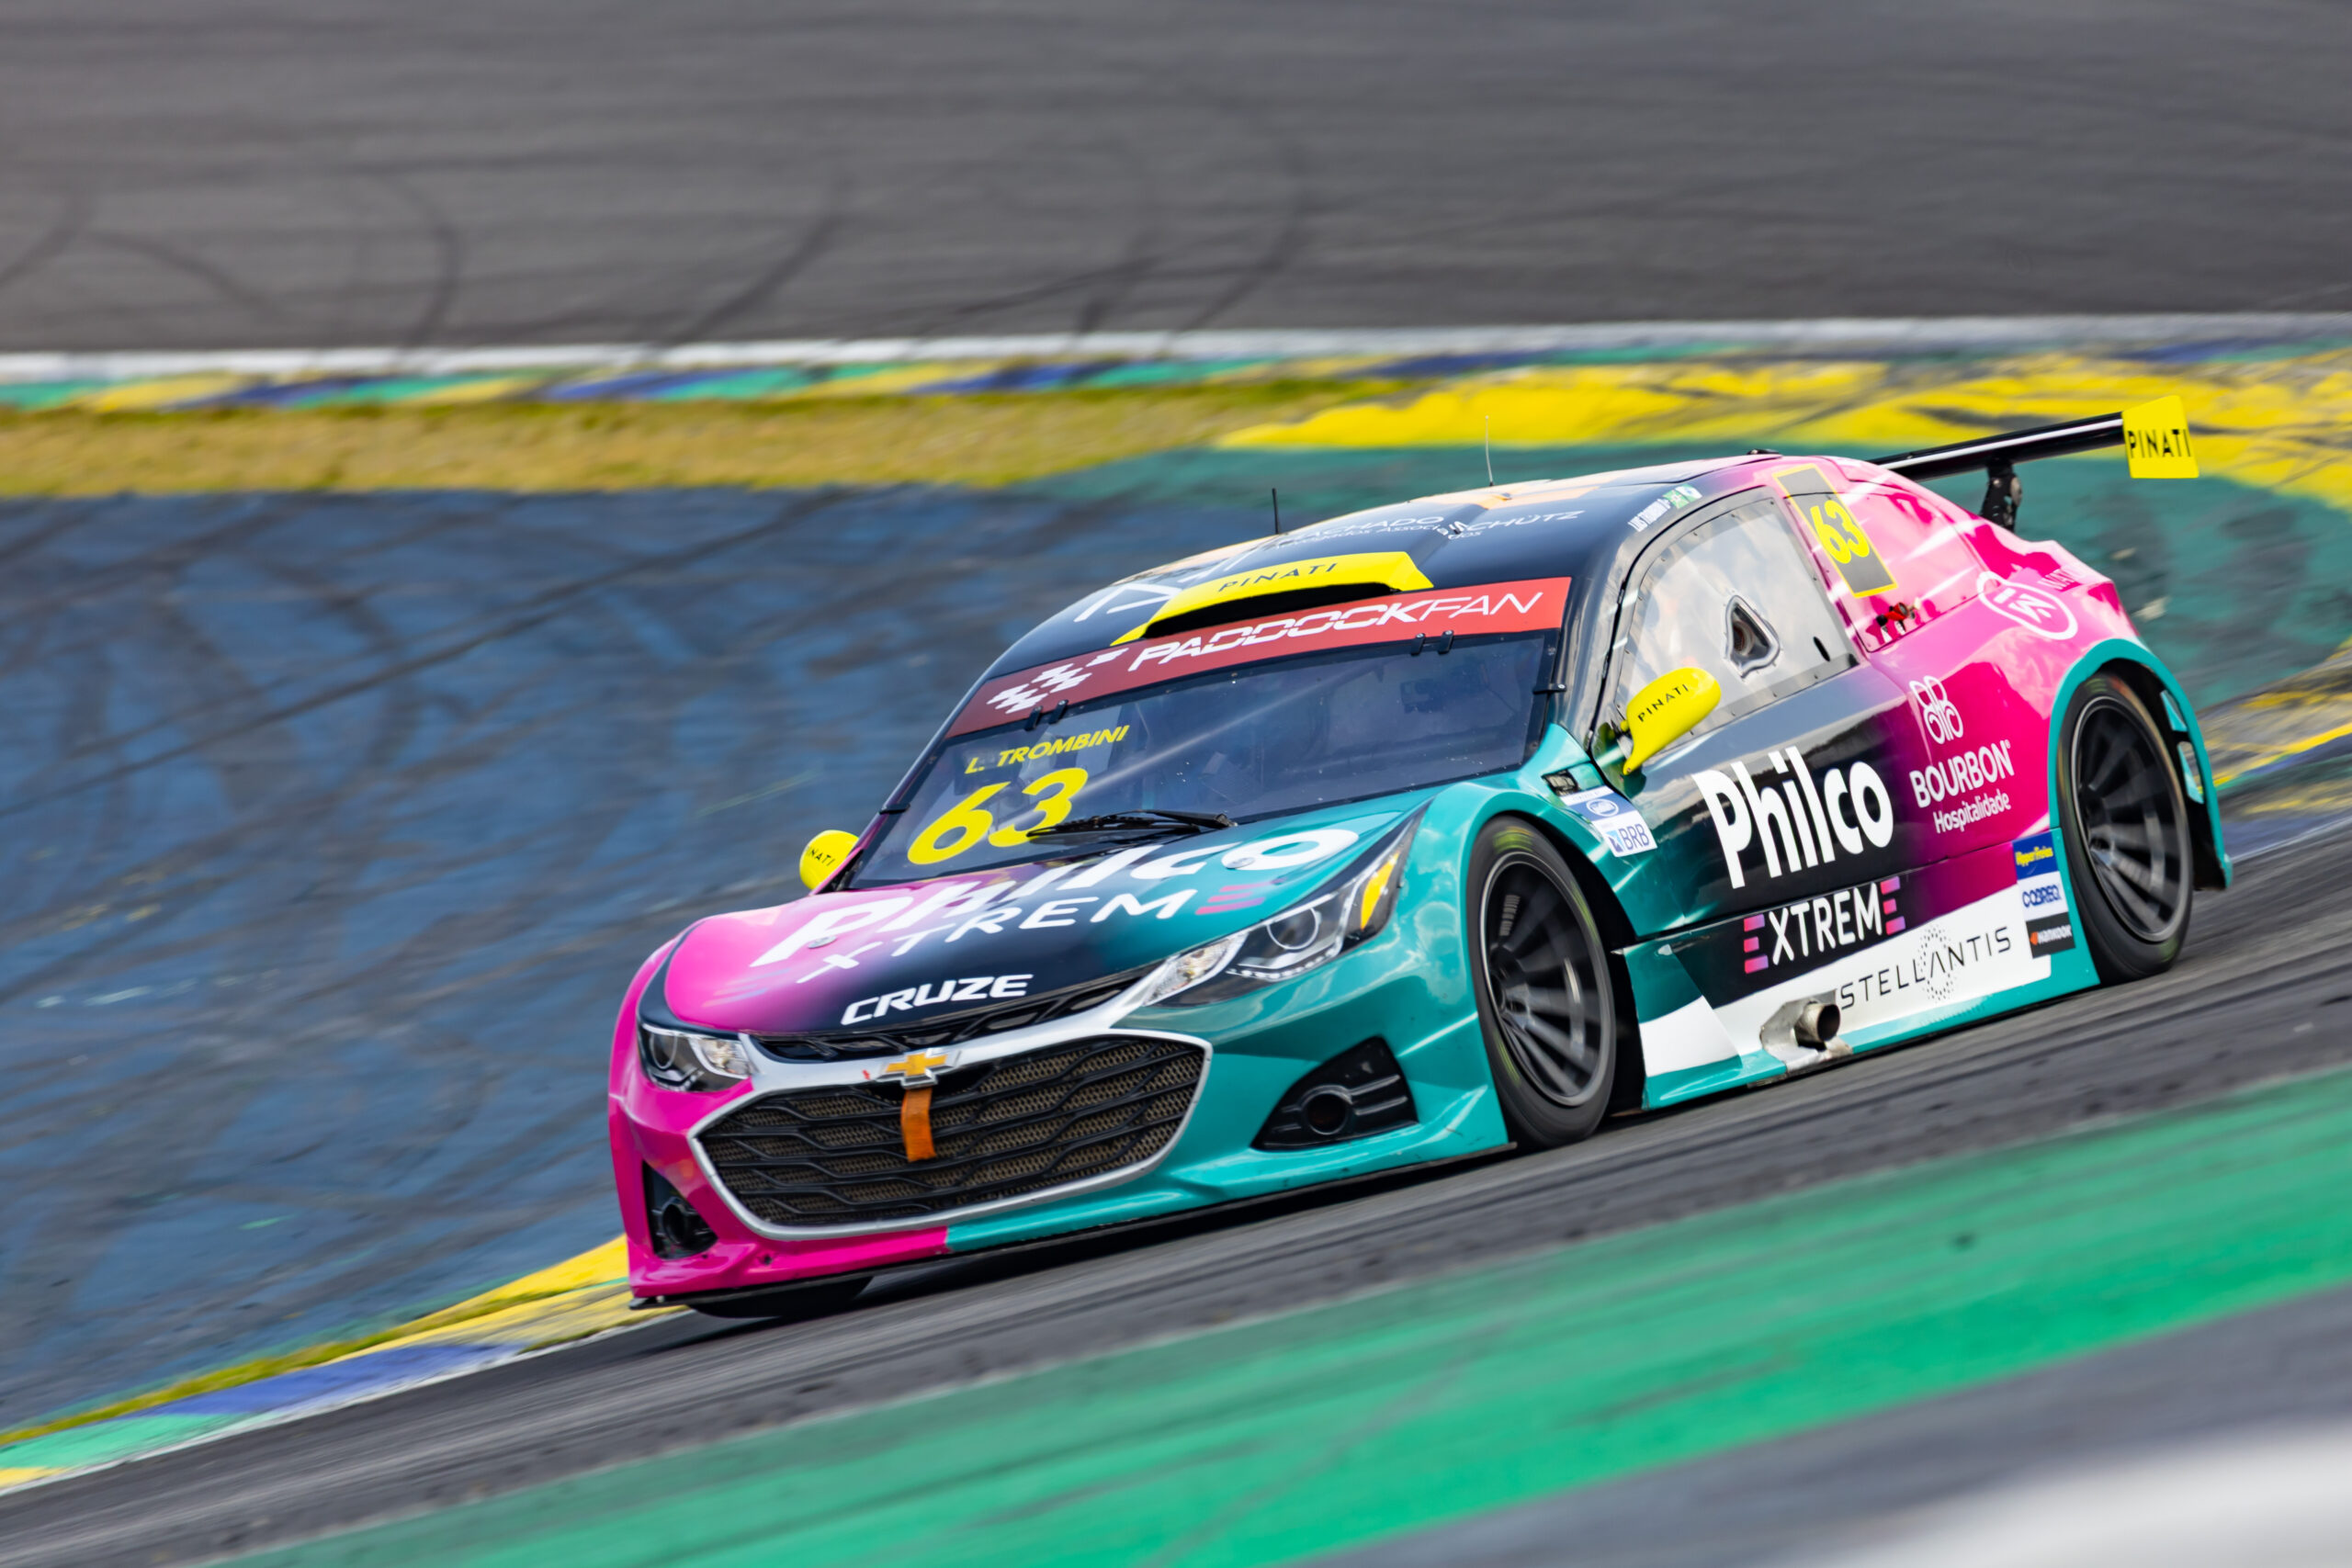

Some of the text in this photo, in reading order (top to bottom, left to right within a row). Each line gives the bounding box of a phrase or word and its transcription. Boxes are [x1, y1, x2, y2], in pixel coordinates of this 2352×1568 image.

[2127, 428, 2192, 459] PINATI
[1809, 499, 1871, 564] 63
[1219, 562, 1339, 593] PINATI
[1637, 683, 1689, 723] PINATI
[965, 725, 1131, 774] L. TROMBINI
[907, 767, 1089, 864] 63
[1690, 745, 1894, 889] Philco
[1933, 788, 2012, 834] Hospitalidade
[1618, 823, 1650, 851] BRB
[1840, 926, 2012, 1010] STELLANTIS
[840, 974, 1035, 1025] CRUZE
